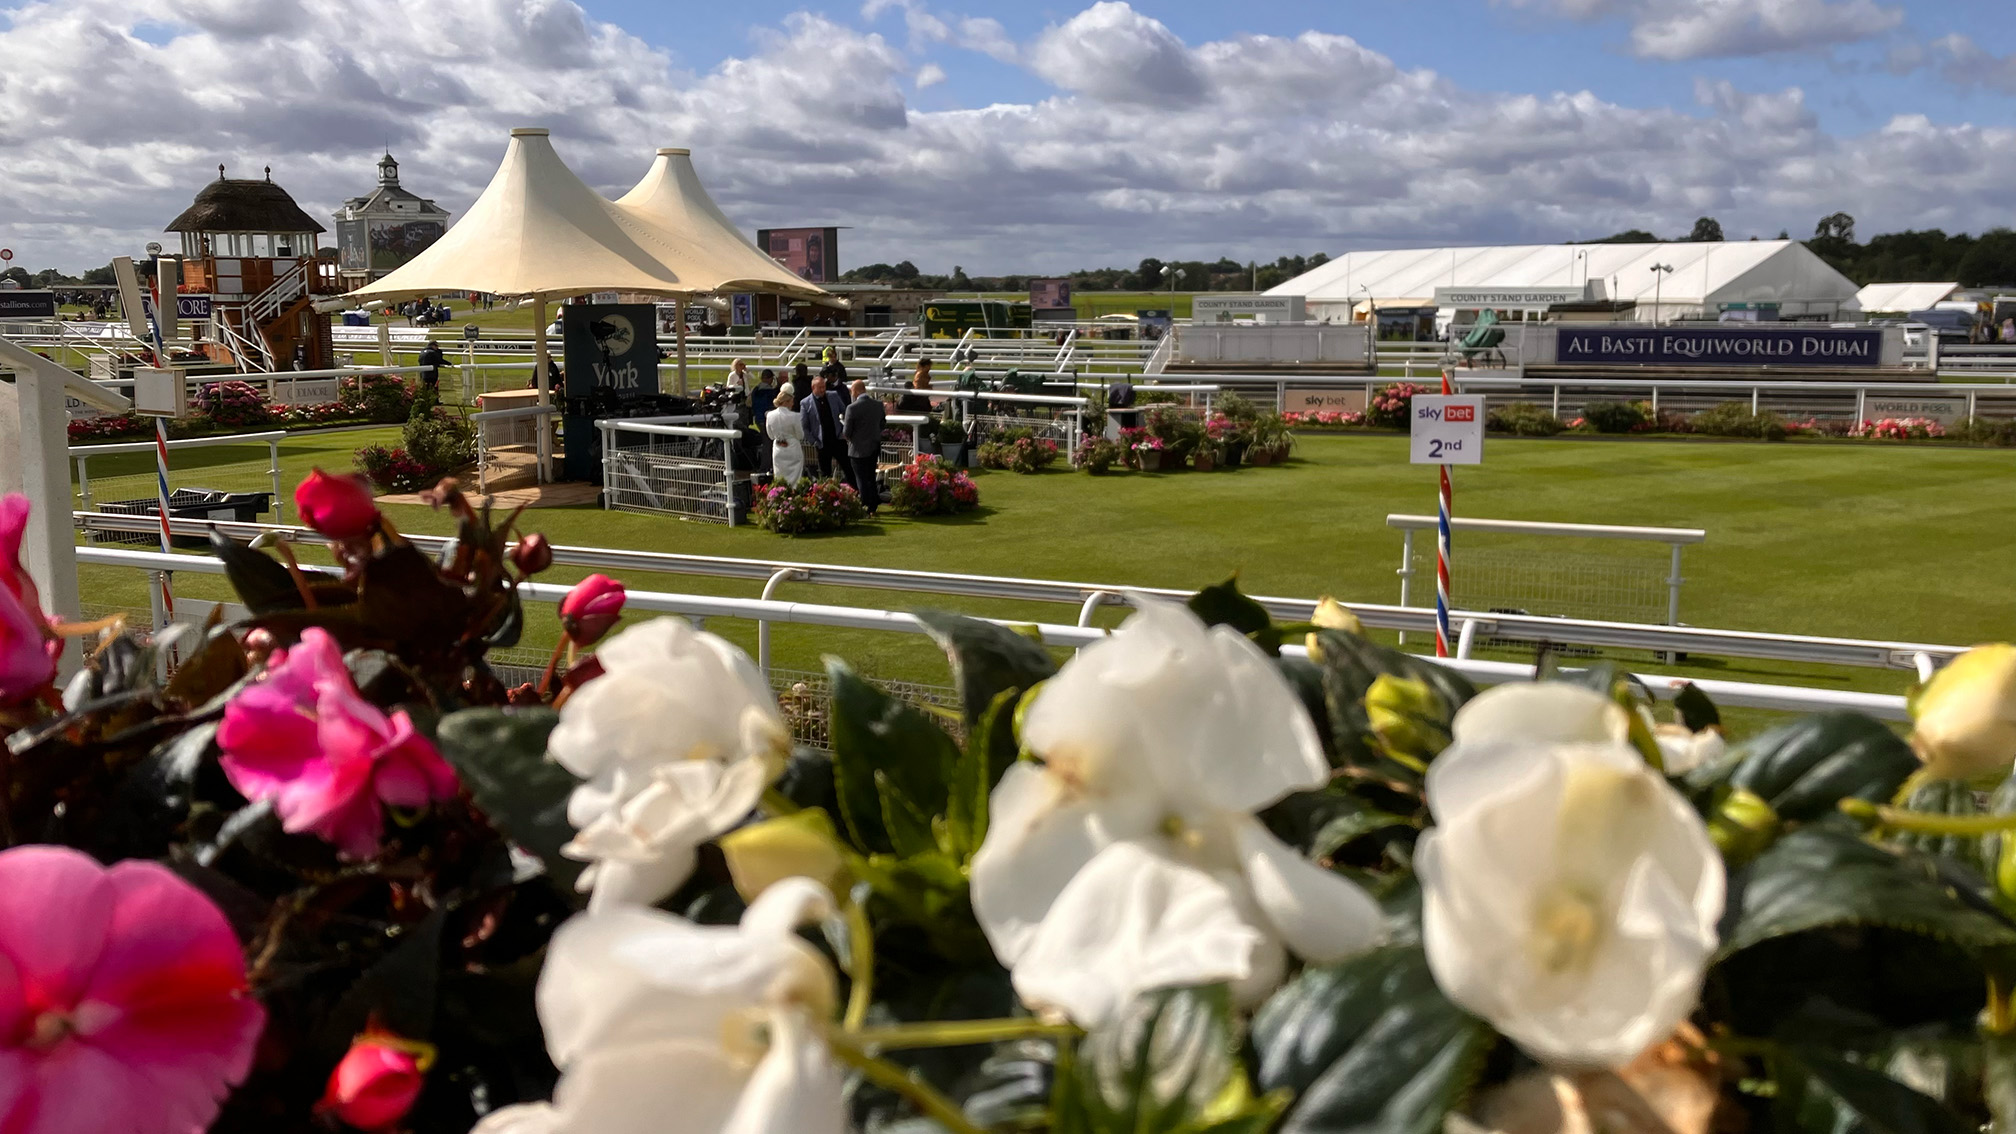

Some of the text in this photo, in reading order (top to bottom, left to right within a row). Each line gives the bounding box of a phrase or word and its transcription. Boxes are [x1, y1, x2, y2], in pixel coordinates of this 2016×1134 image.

[0, 300, 47, 309] stallions.com
[1450, 294, 1567, 302] COUNTY STAND GARDEN
[1568, 336, 1869, 357] AL BASTI EQUIWORLD DUBAI
[591, 360, 639, 390] York
[1305, 395, 1346, 407] sky bet
[1418, 406, 1472, 421] sky bet
[1873, 402, 1954, 415] WORLD POOL
[1428, 439, 1463, 458] 2nd
